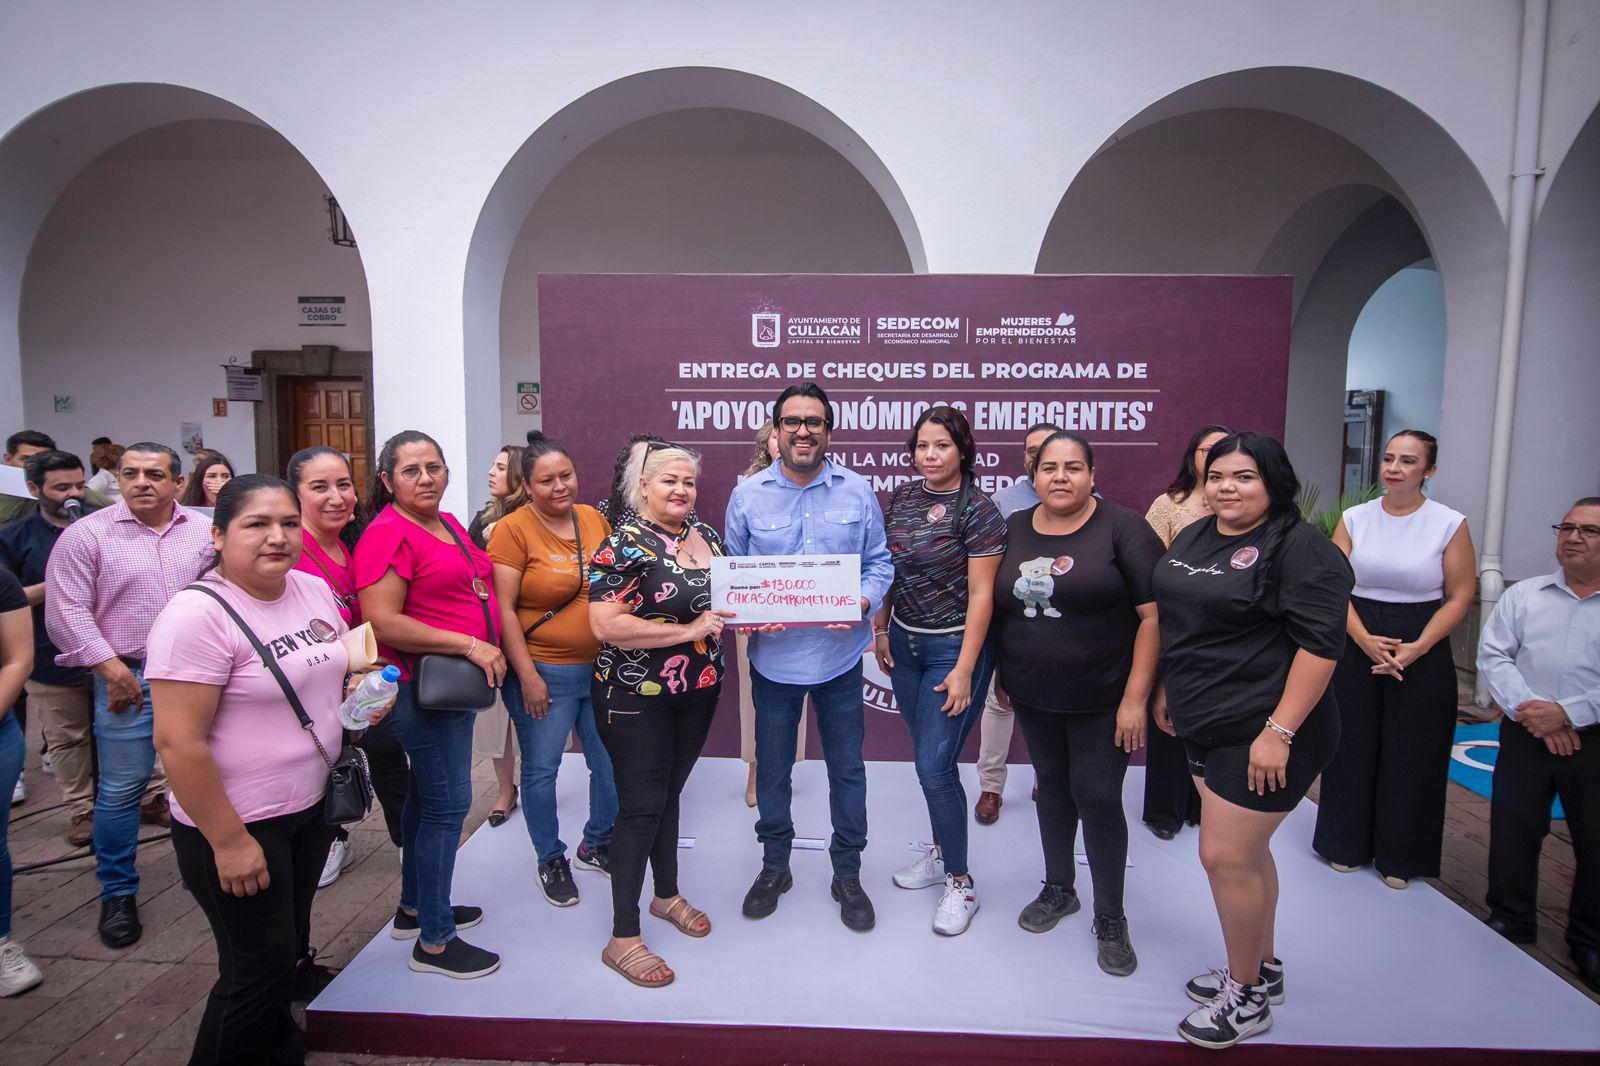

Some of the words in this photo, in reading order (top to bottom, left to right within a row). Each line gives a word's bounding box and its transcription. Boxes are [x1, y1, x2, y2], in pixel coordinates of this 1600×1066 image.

[876, 317, 960, 330] SEDECOM
[1001, 317, 1052, 326] MUJERES
[787, 325, 861, 336] CULIACÁN
[976, 327, 1077, 336] EMPRENDEDORAS
[678, 362, 781, 379] ENTREGA
[786, 362, 817, 379] DE
[822, 362, 927, 382] CHEQUES
[932, 362, 975, 379] DEL
[981, 362, 1111, 379] PROGRAMA
[1117, 362, 1148, 379] DE
[852, 452, 877, 467] LA
[726, 591, 767, 605] CHICAS
[767, 592, 857, 607] COMPROMETIDAS
